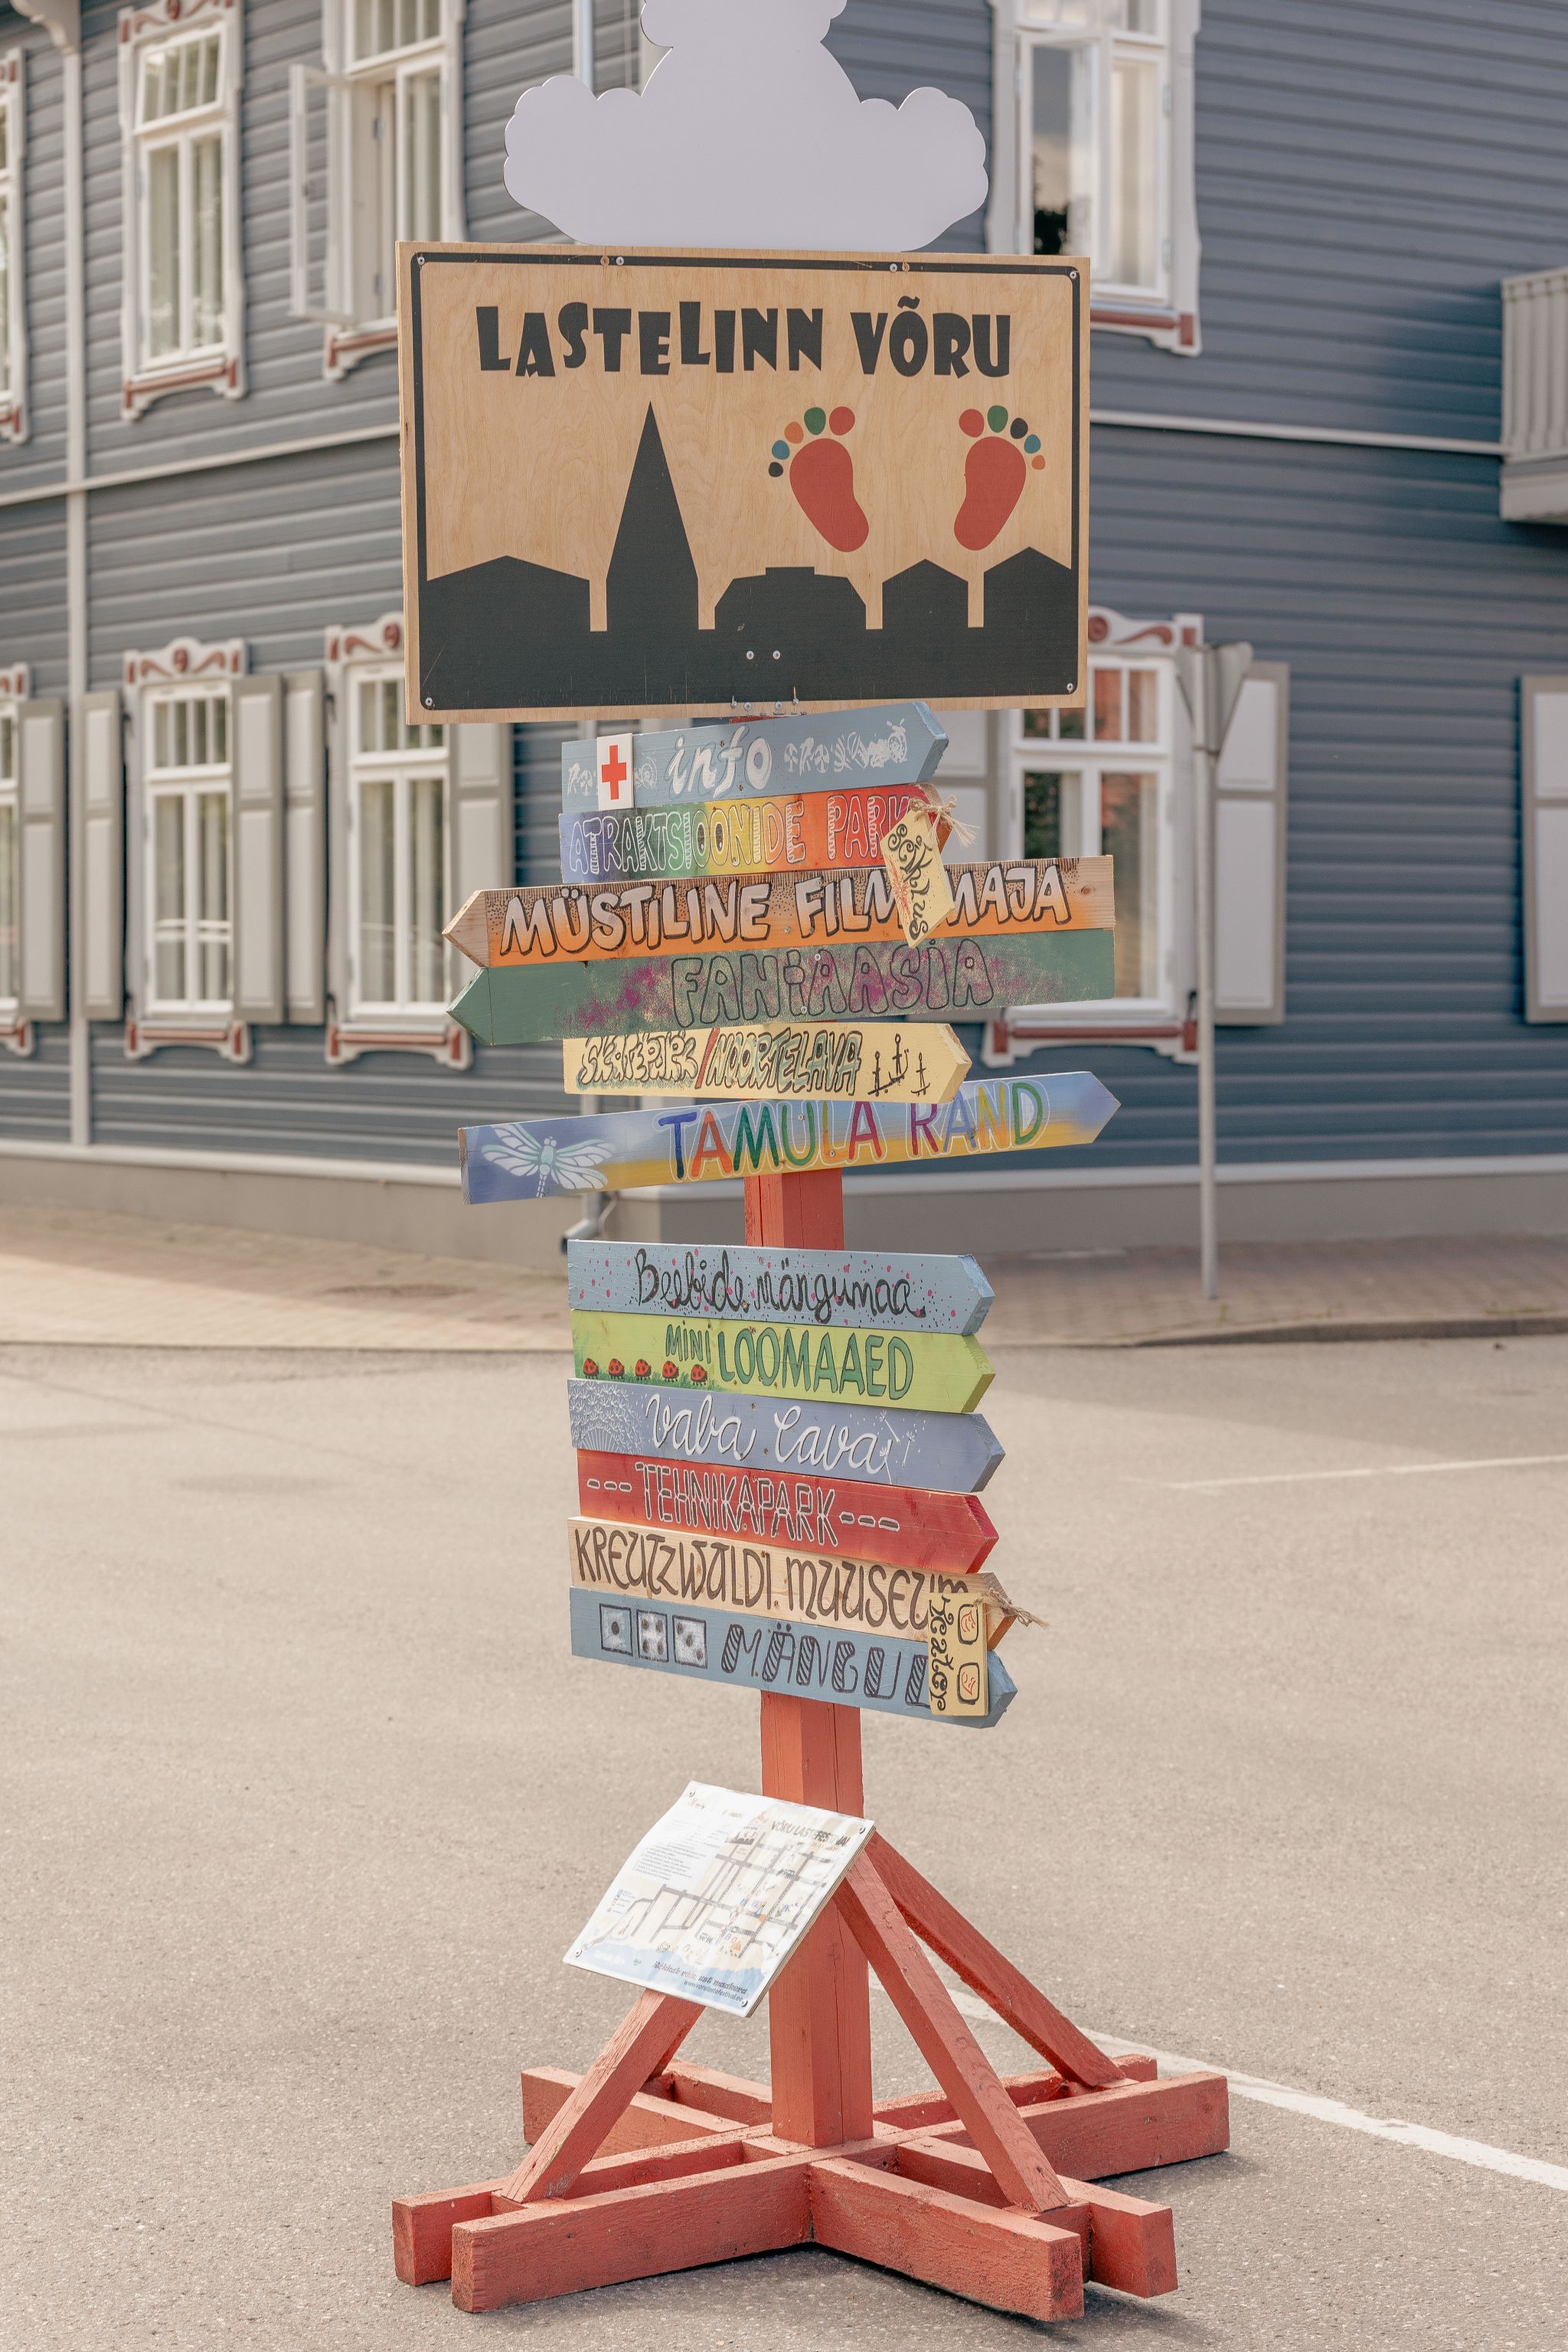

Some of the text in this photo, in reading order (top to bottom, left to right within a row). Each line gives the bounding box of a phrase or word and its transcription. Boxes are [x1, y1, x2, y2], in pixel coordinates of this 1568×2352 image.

[475, 296, 1011, 379] LASTELINN VÕRU
[667, 727, 772, 799] info
[569, 802, 805, 875] ATRAKTSIOONIDE
[500, 864, 1072, 957] MÜSTILINE FILM MAJA
[657, 1082, 1044, 1180] TAMULA RAND
[635, 1248, 926, 1325] Beebide mängumaa
[717, 1327, 914, 1400] LOOMAAED
